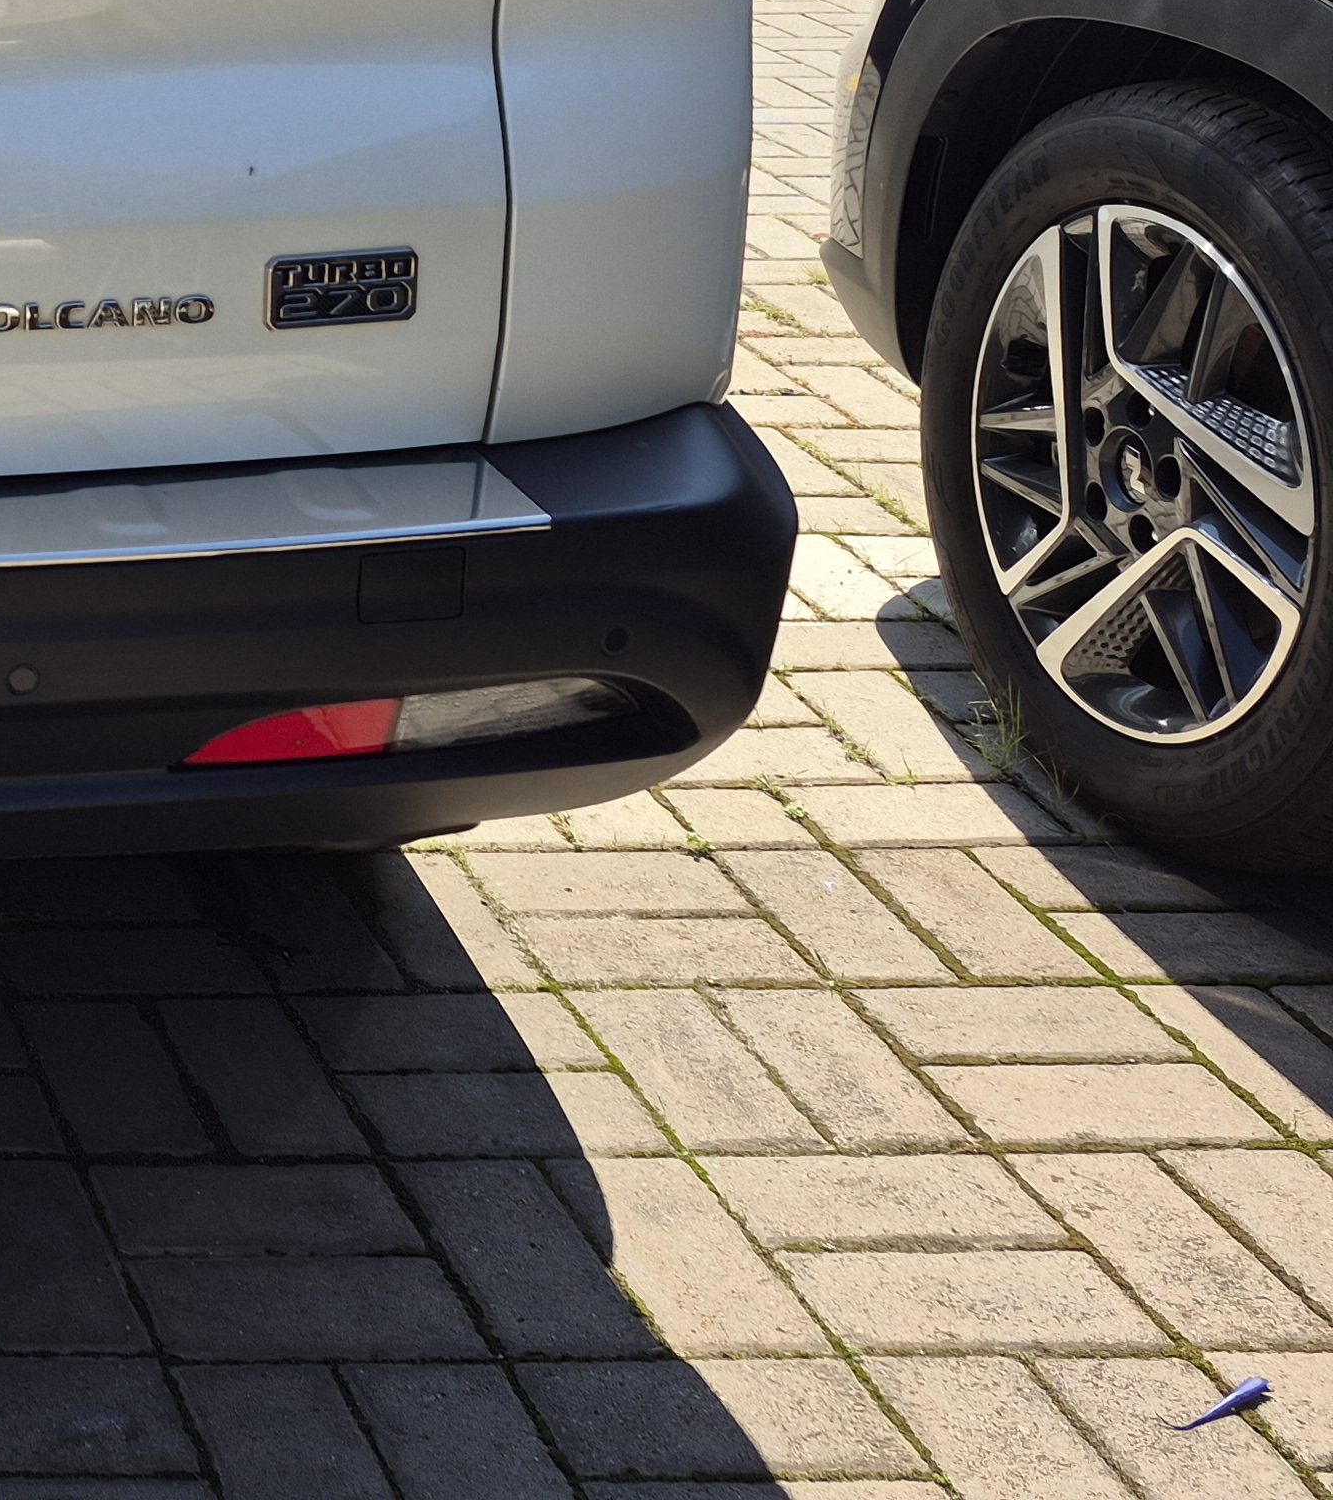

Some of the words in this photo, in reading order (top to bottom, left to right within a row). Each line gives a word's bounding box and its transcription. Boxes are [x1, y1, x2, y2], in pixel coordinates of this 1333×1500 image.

[935, 155, 1053, 347] GOODYEAR
[276, 256, 415, 288] TURBO
[279, 281, 413, 320] 270
